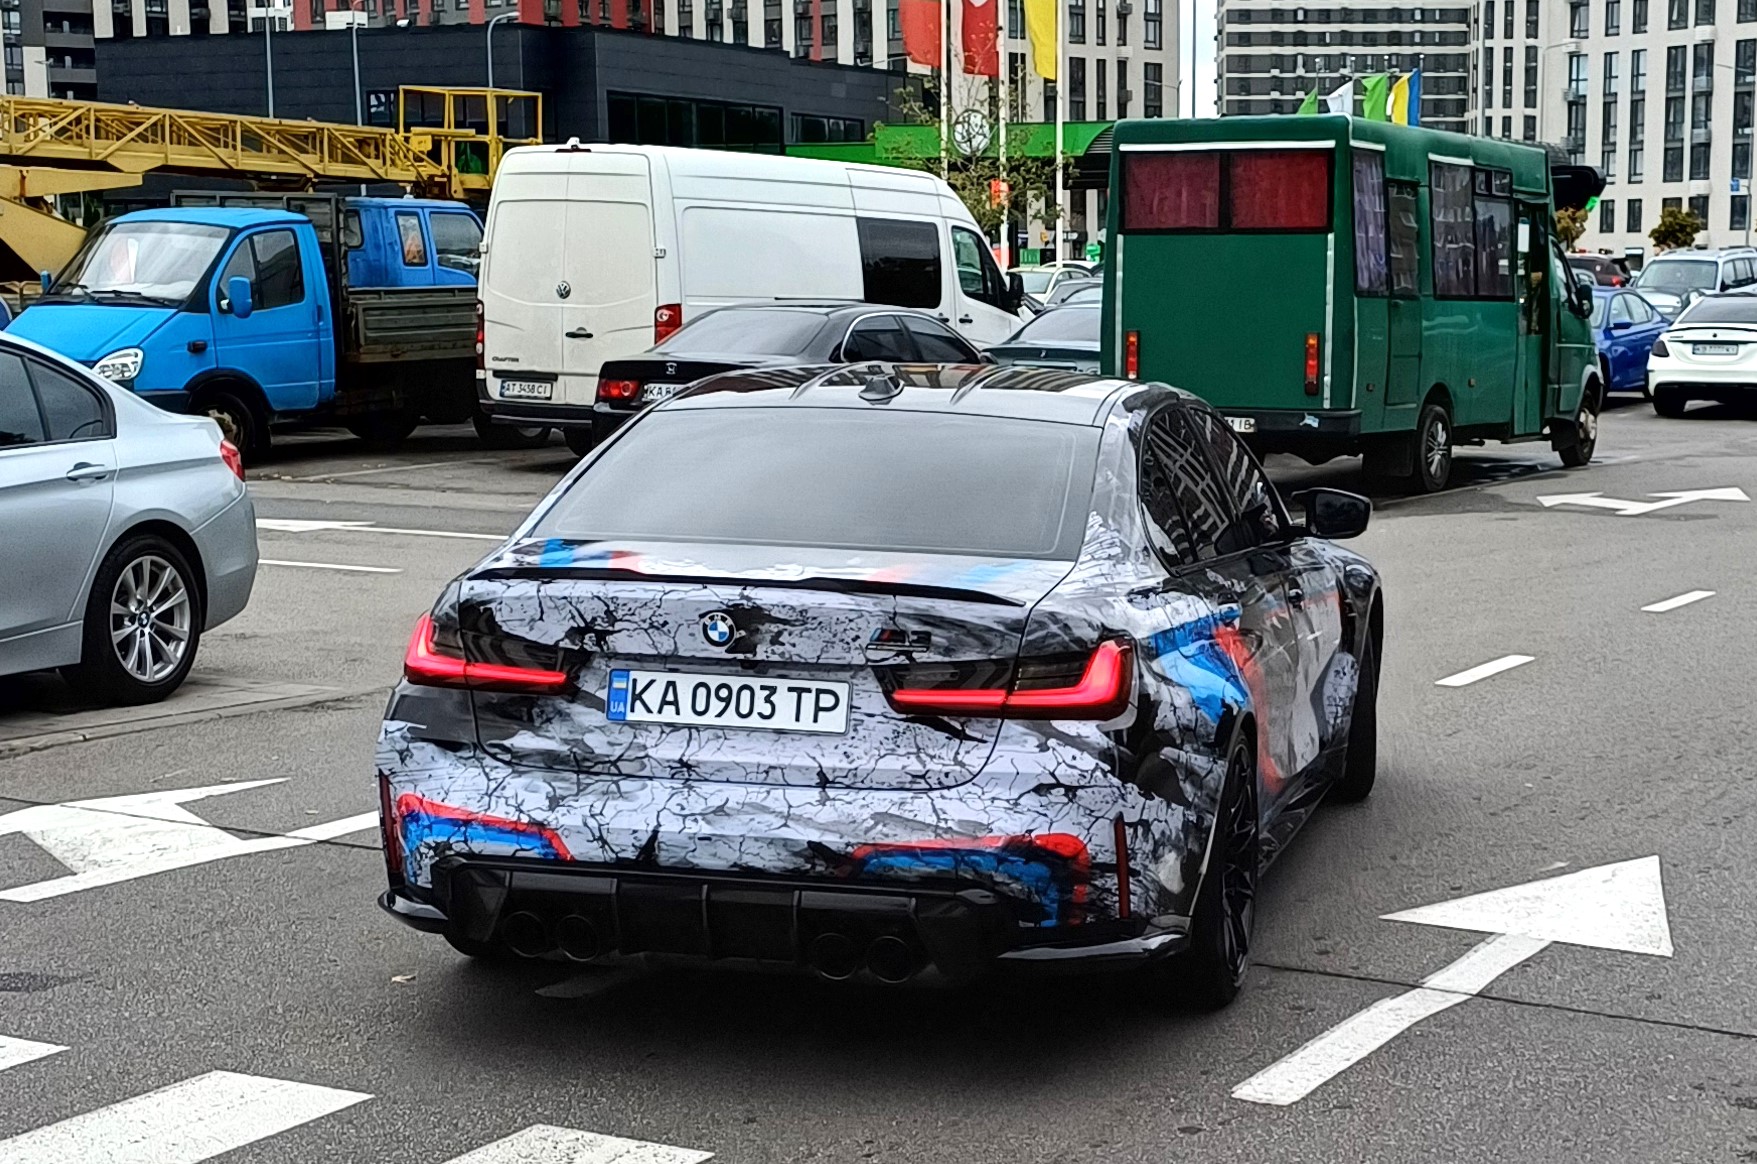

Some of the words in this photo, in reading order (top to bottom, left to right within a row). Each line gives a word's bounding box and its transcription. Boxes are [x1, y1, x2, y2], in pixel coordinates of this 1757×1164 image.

[649, 386, 663, 397] KA
[629, 677, 681, 716] KA
[690, 681, 778, 720] 0903
[787, 686, 841, 724] TP
[609, 701, 626, 714] UA
